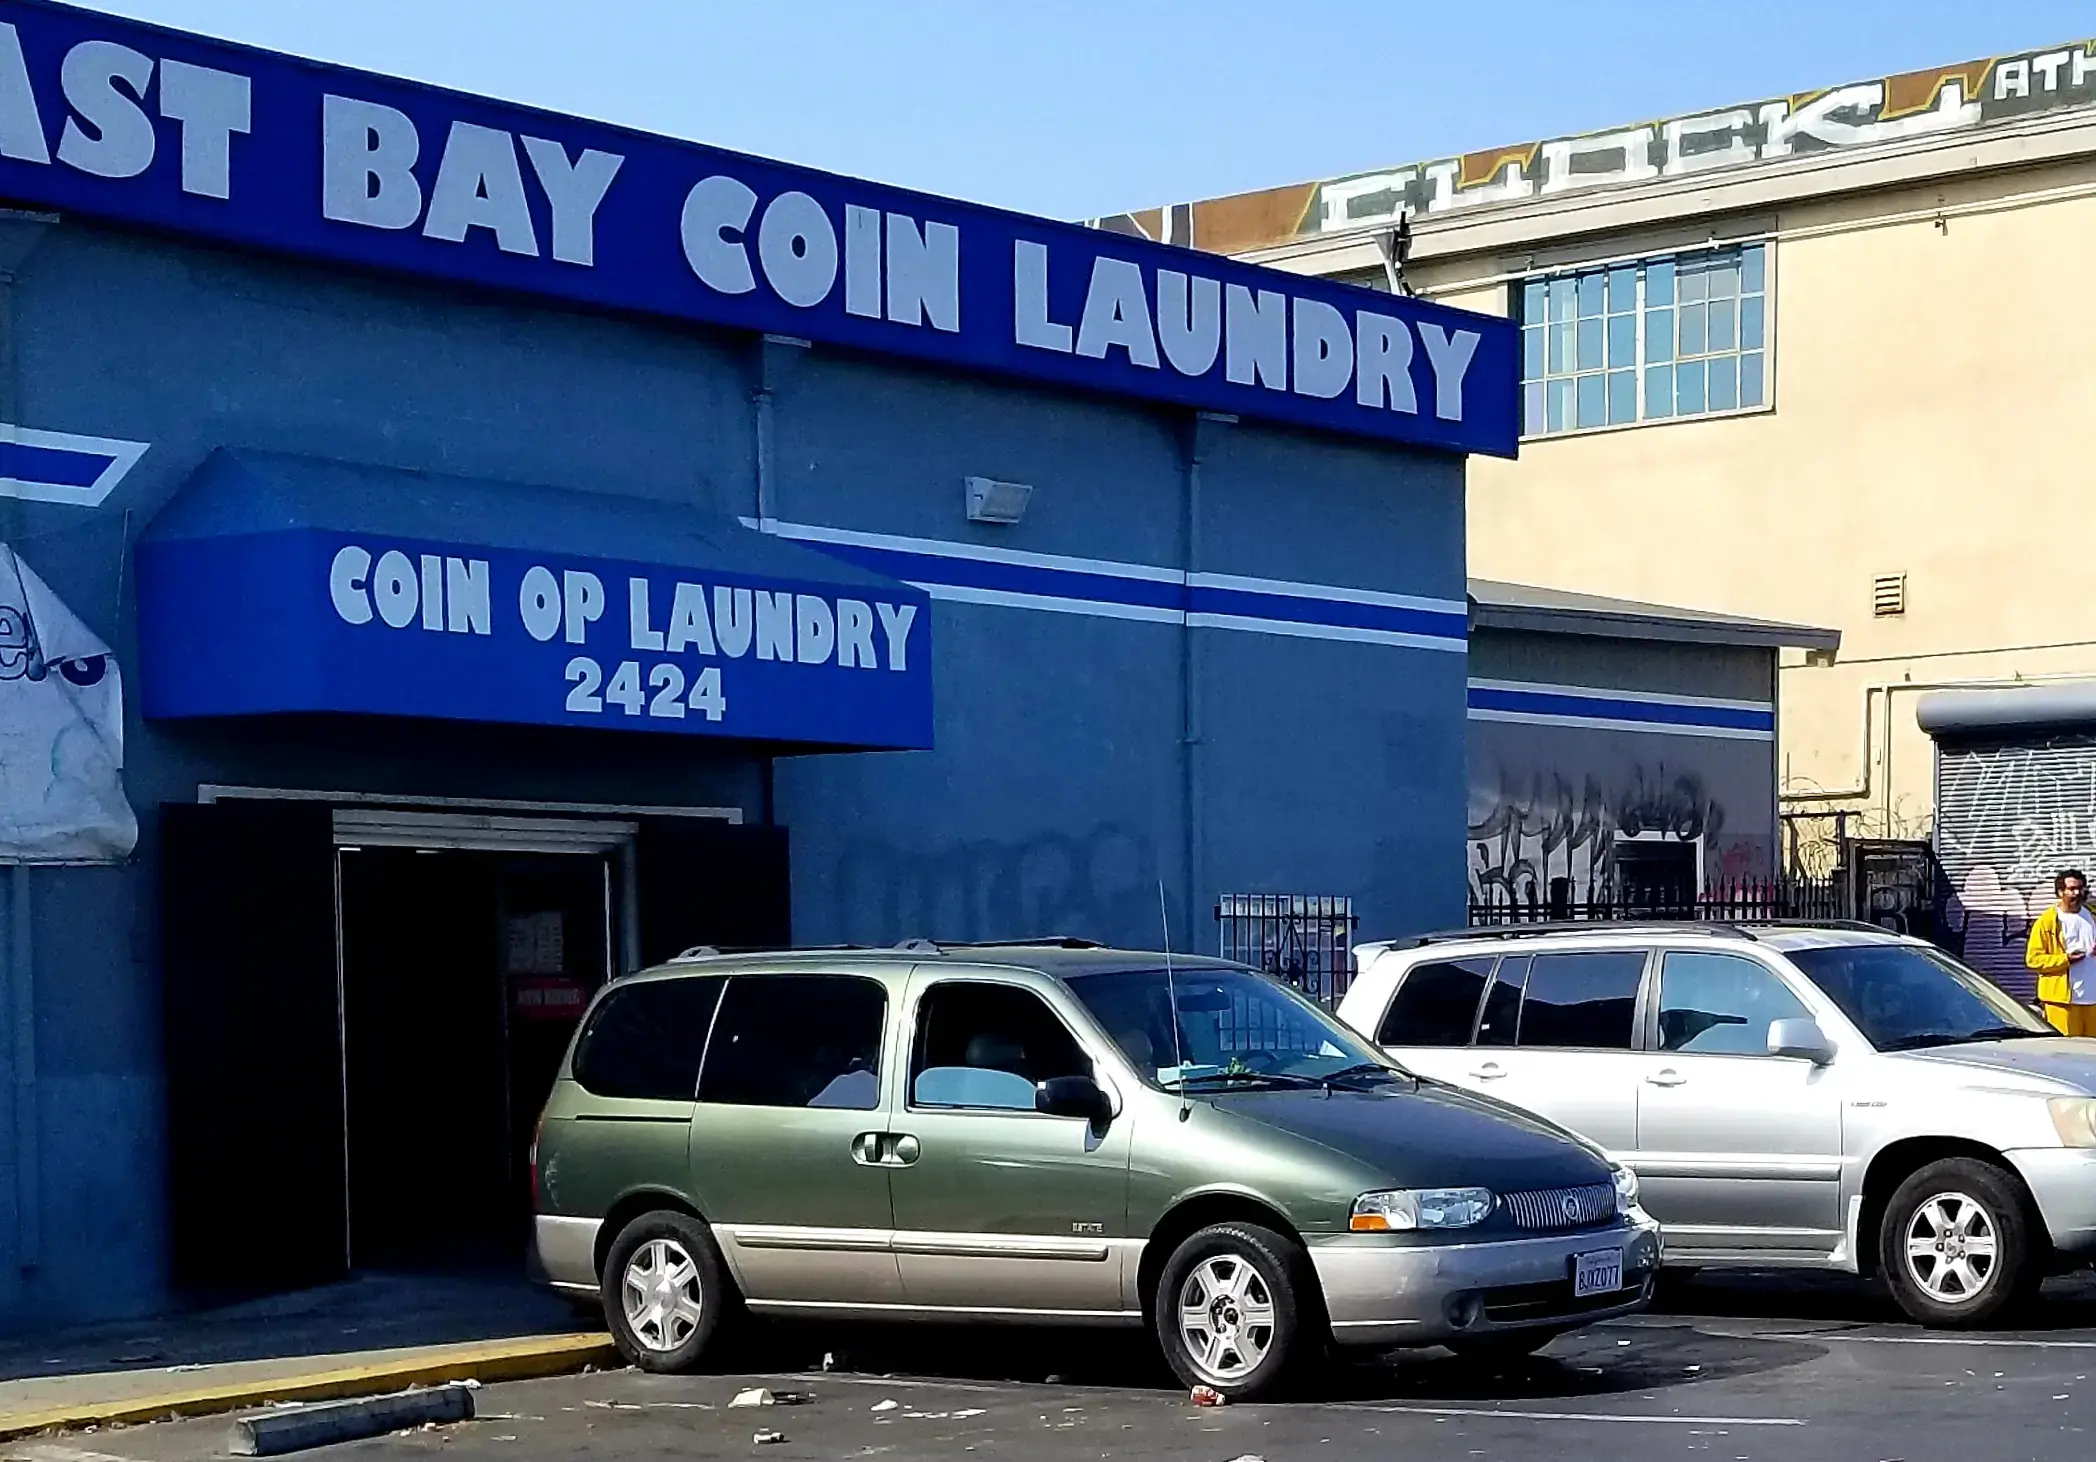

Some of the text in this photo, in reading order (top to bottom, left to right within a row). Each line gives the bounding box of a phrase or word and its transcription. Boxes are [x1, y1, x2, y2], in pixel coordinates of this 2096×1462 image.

[322, 94, 625, 267] BAY
[680, 175, 960, 333] COIN
[1014, 239, 1482, 422] LAUNDRY
[329, 545, 918, 671] COIN OP LAUNDRY
[564, 656, 726, 722] 2424
